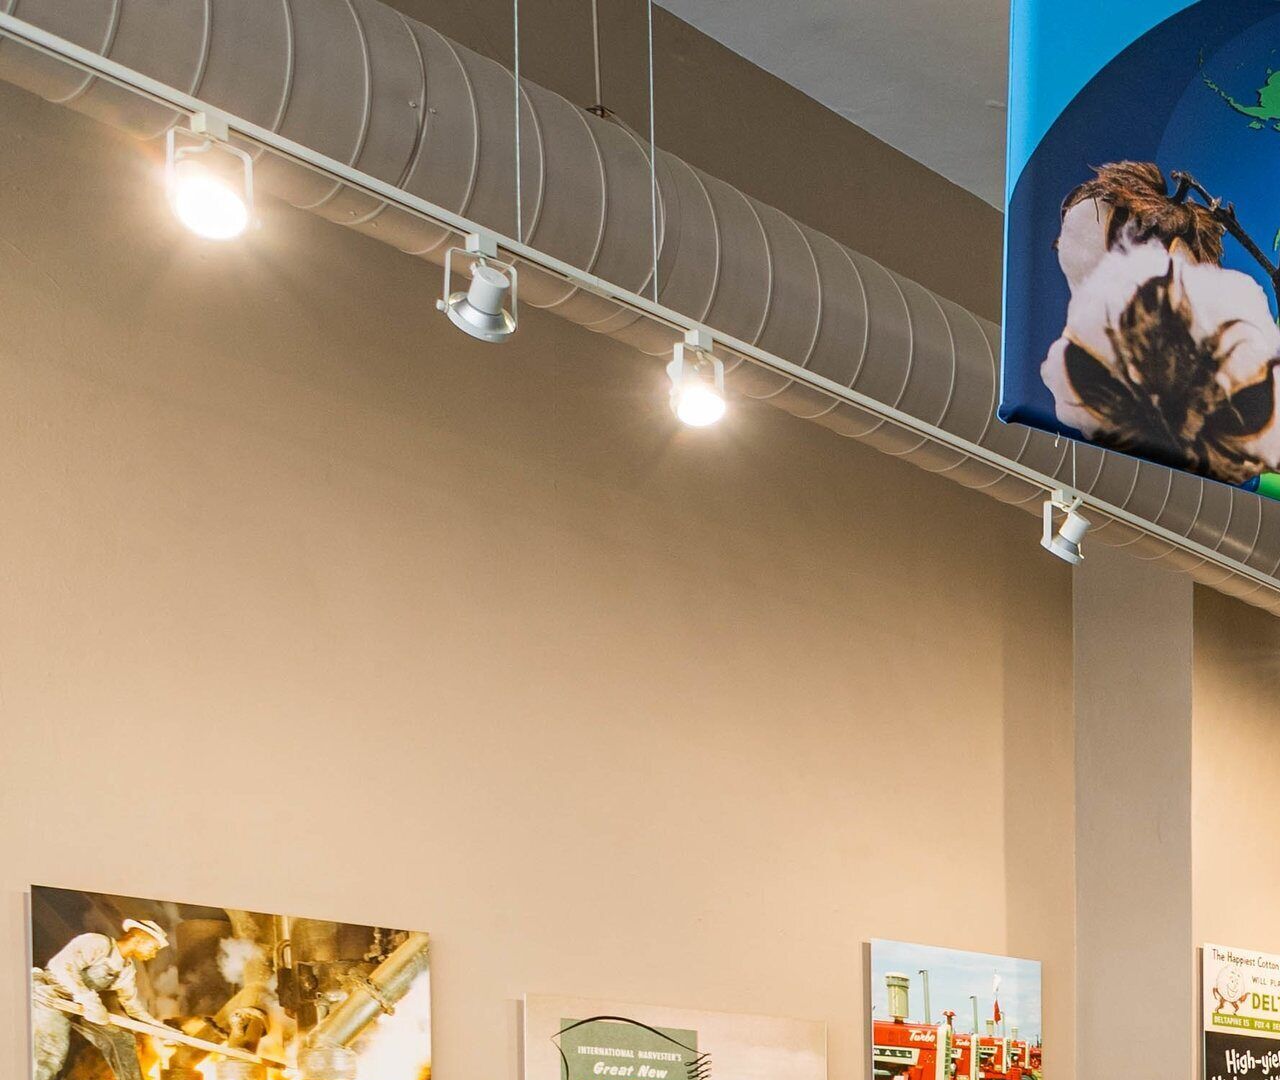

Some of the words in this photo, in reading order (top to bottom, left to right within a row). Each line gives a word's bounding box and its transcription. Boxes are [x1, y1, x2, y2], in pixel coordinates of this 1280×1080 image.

[1213, 949, 1225, 961] The
[1227, 952, 1255, 967] Happiest
[1258, 957, 1279, 970] Cotton
[1252, 976, 1266, 985] WILL
[909, 1029, 936, 1043] Turbo
[578, 1046, 634, 1058] INTERNATIONAL
[593, 1062, 633, 1075] Great
[638, 1065, 667, 1079] New
